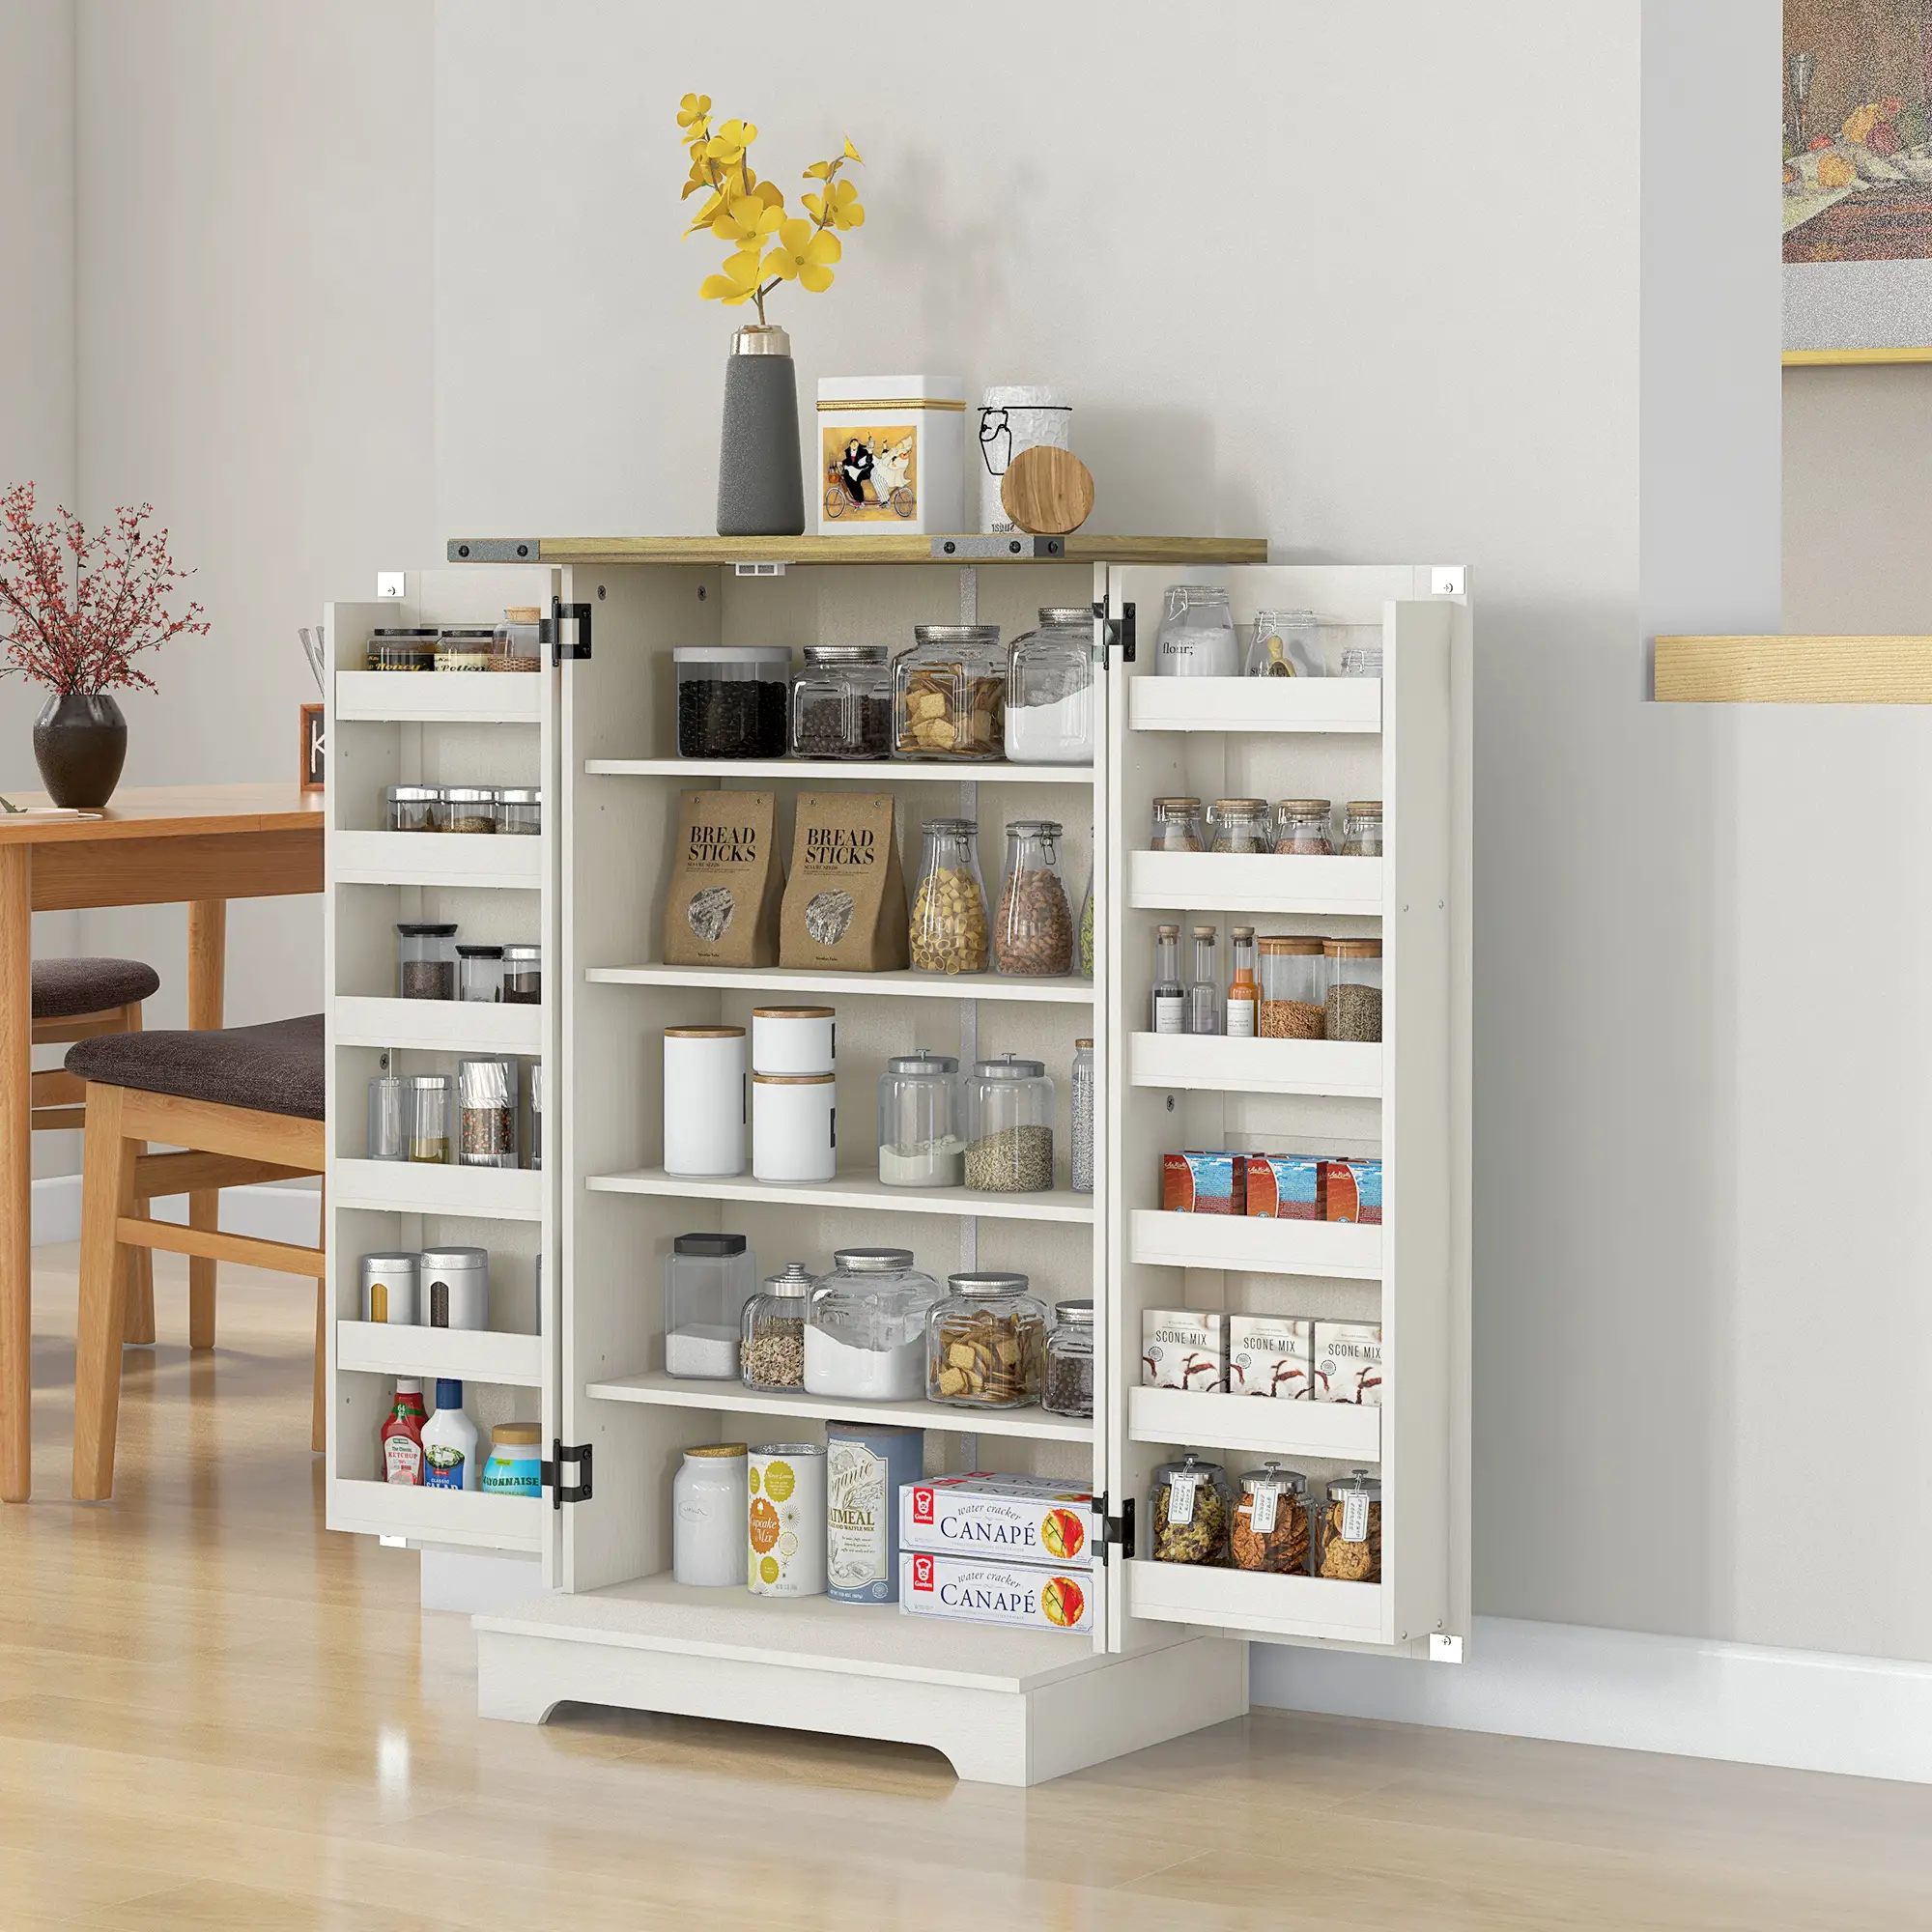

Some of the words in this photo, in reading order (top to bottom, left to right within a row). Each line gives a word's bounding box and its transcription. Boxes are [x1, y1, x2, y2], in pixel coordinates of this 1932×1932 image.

[1250, 667, 1286, 677] suar;
[689, 826, 756, 844] BREAD
[807, 828, 874, 847] BREAD
[688, 844, 756, 863] STICKS
[805, 846, 874, 866] STICKS
[1155, 1330, 1186, 1345] SCONE
[1189, 1333, 1208, 1346] MIX
[1243, 1337, 1275, 1351] SCONE
[1278, 1340, 1295, 1352] MIX
[1327, 1344, 1360, 1357] SCONE
[1363, 1347, 1381, 1359] MIX
[829, 1507, 875, 1525] ATMEAL
[914, 1513, 932, 1521] Garden
[957, 1503, 984, 1516] water
[986, 1503, 1021, 1521] cracker
[754, 1529, 774, 1543] Mix
[940, 1516, 1037, 1547] CANAPÉ
[957, 1571, 984, 1583] water
[986, 1571, 1021, 1589] cracker
[940, 1583, 1037, 1614] CANAPÉ
